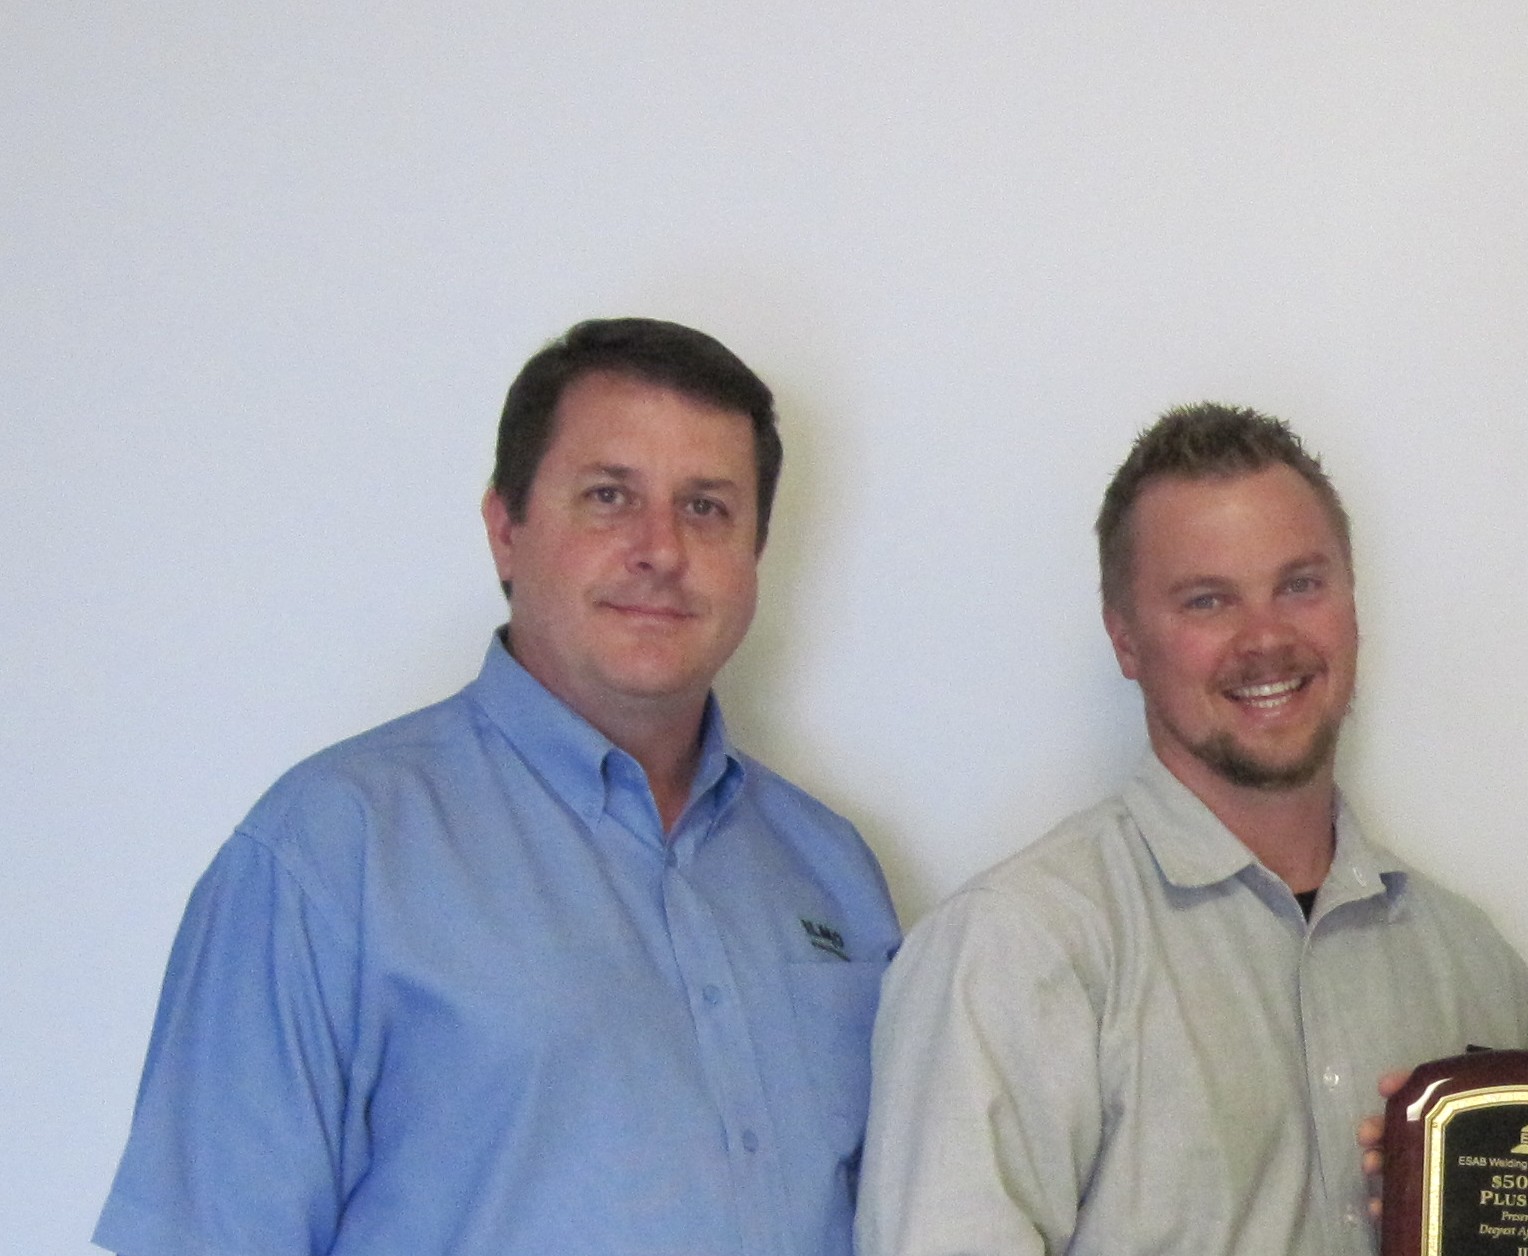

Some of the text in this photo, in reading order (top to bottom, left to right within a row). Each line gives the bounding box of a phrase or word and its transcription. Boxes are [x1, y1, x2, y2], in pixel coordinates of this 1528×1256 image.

[1458, 1156, 1487, 1167] ESAB
[1489, 1157, 1528, 1170] Welding
[1479, 1223, 1516, 1239] Deepest
